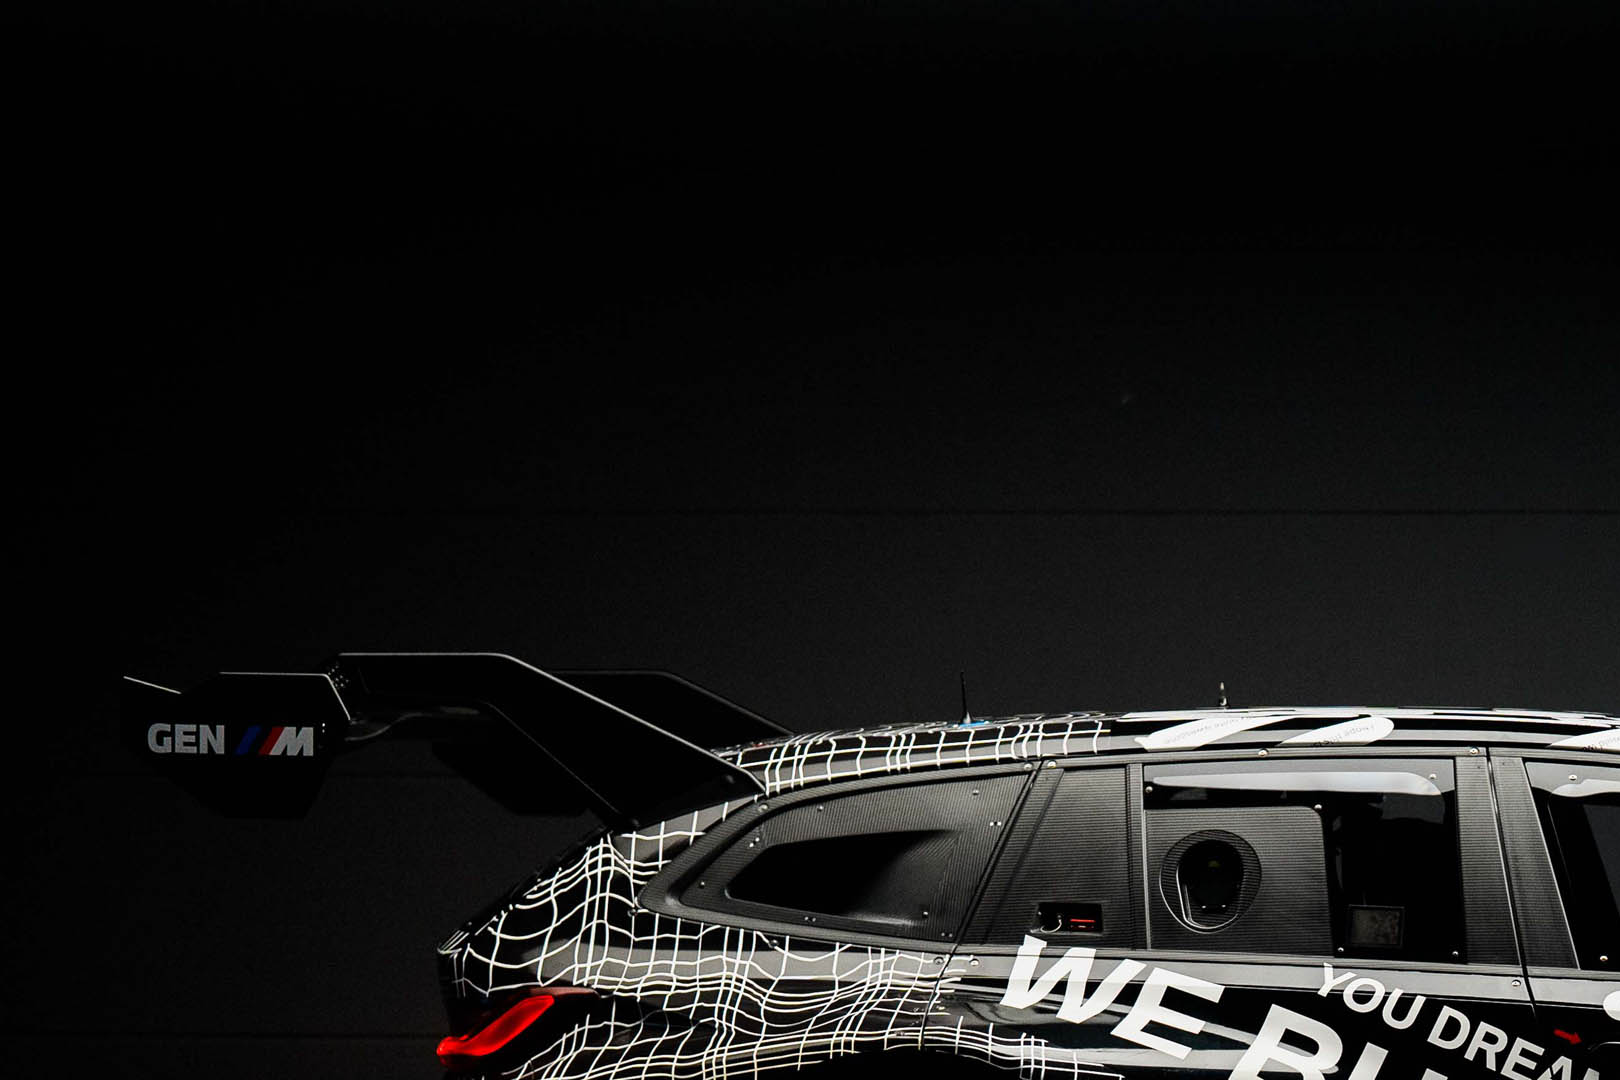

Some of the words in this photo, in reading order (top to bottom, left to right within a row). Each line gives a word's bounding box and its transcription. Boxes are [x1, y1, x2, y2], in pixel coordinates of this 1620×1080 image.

[147, 723, 225, 754] GEN
[1000, 934, 1225, 1060] WE
[1317, 962, 1427, 1029] YOU
